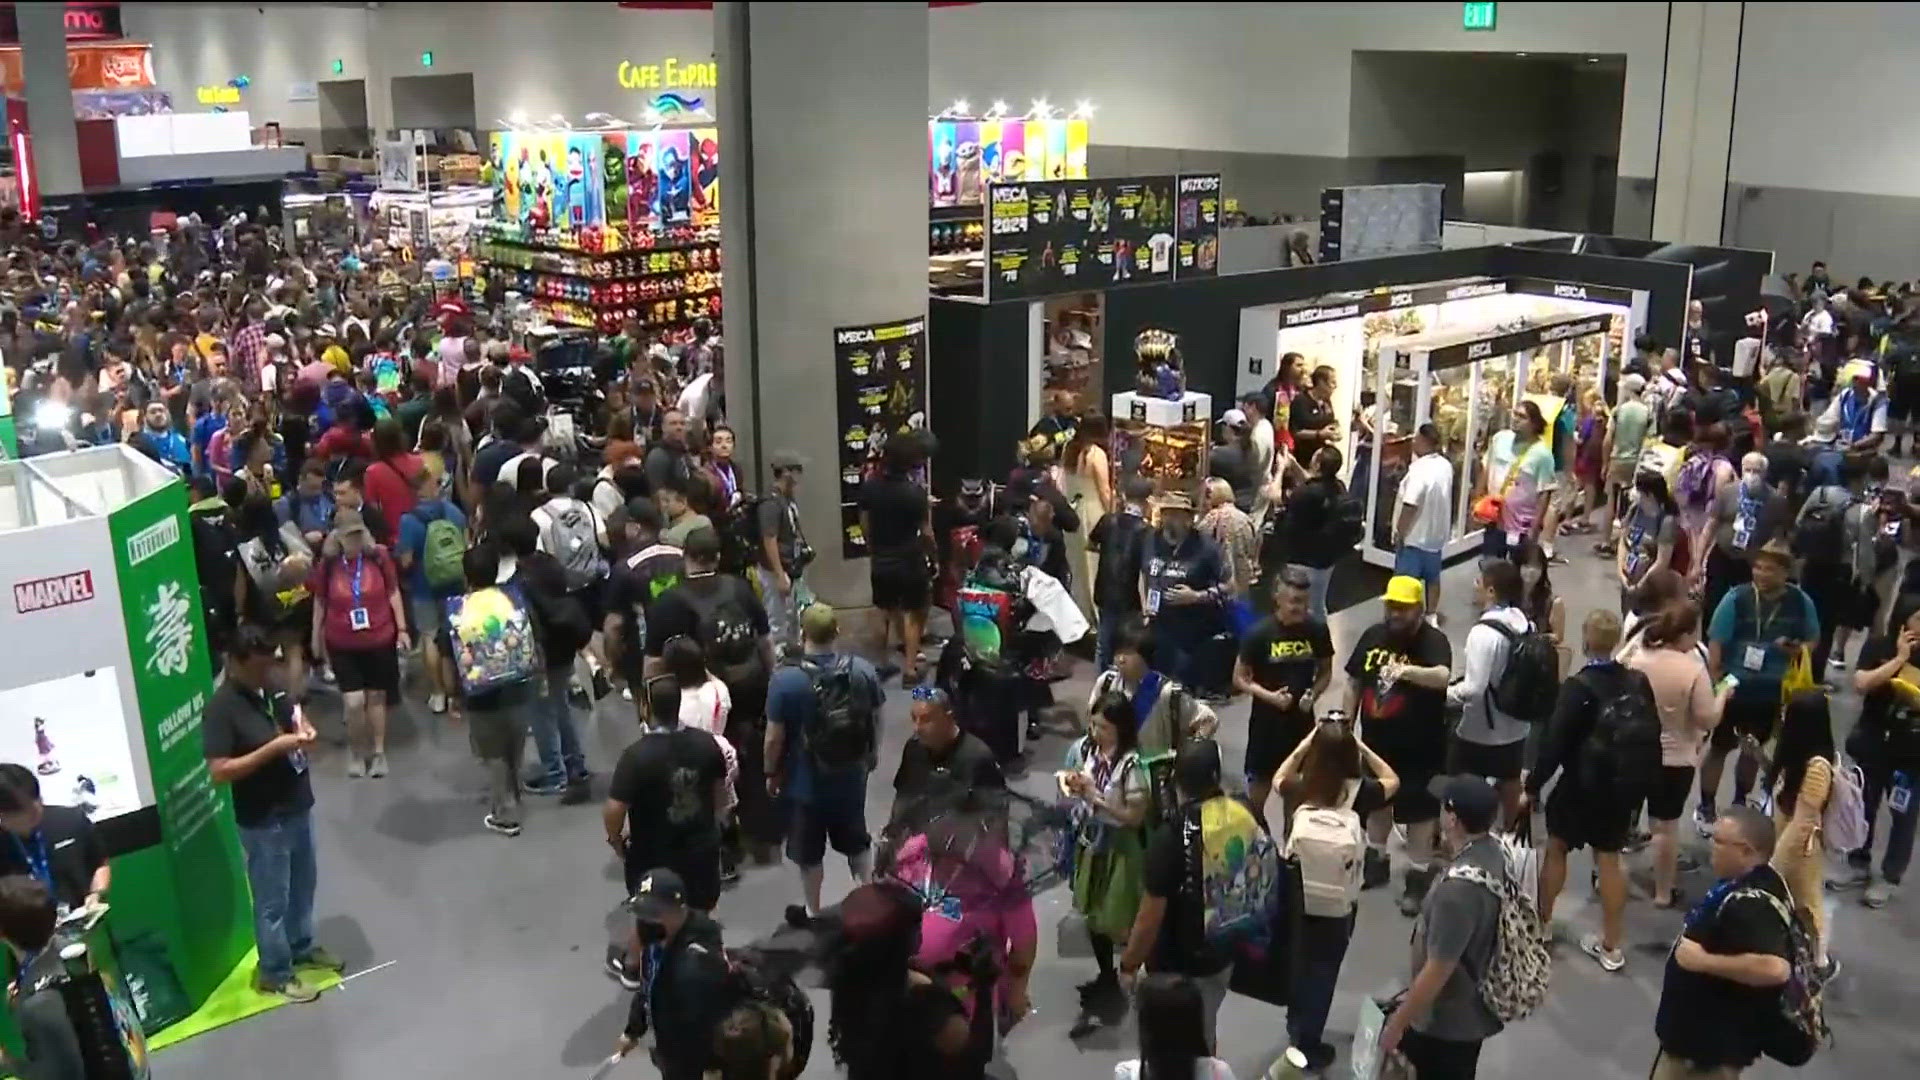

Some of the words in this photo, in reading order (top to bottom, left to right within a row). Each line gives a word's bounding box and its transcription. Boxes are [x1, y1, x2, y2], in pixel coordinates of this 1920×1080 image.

[619, 60, 660, 89] CAFE
[15, 572, 94, 613] MARVEL
[1271, 640, 1313, 658] NECA
